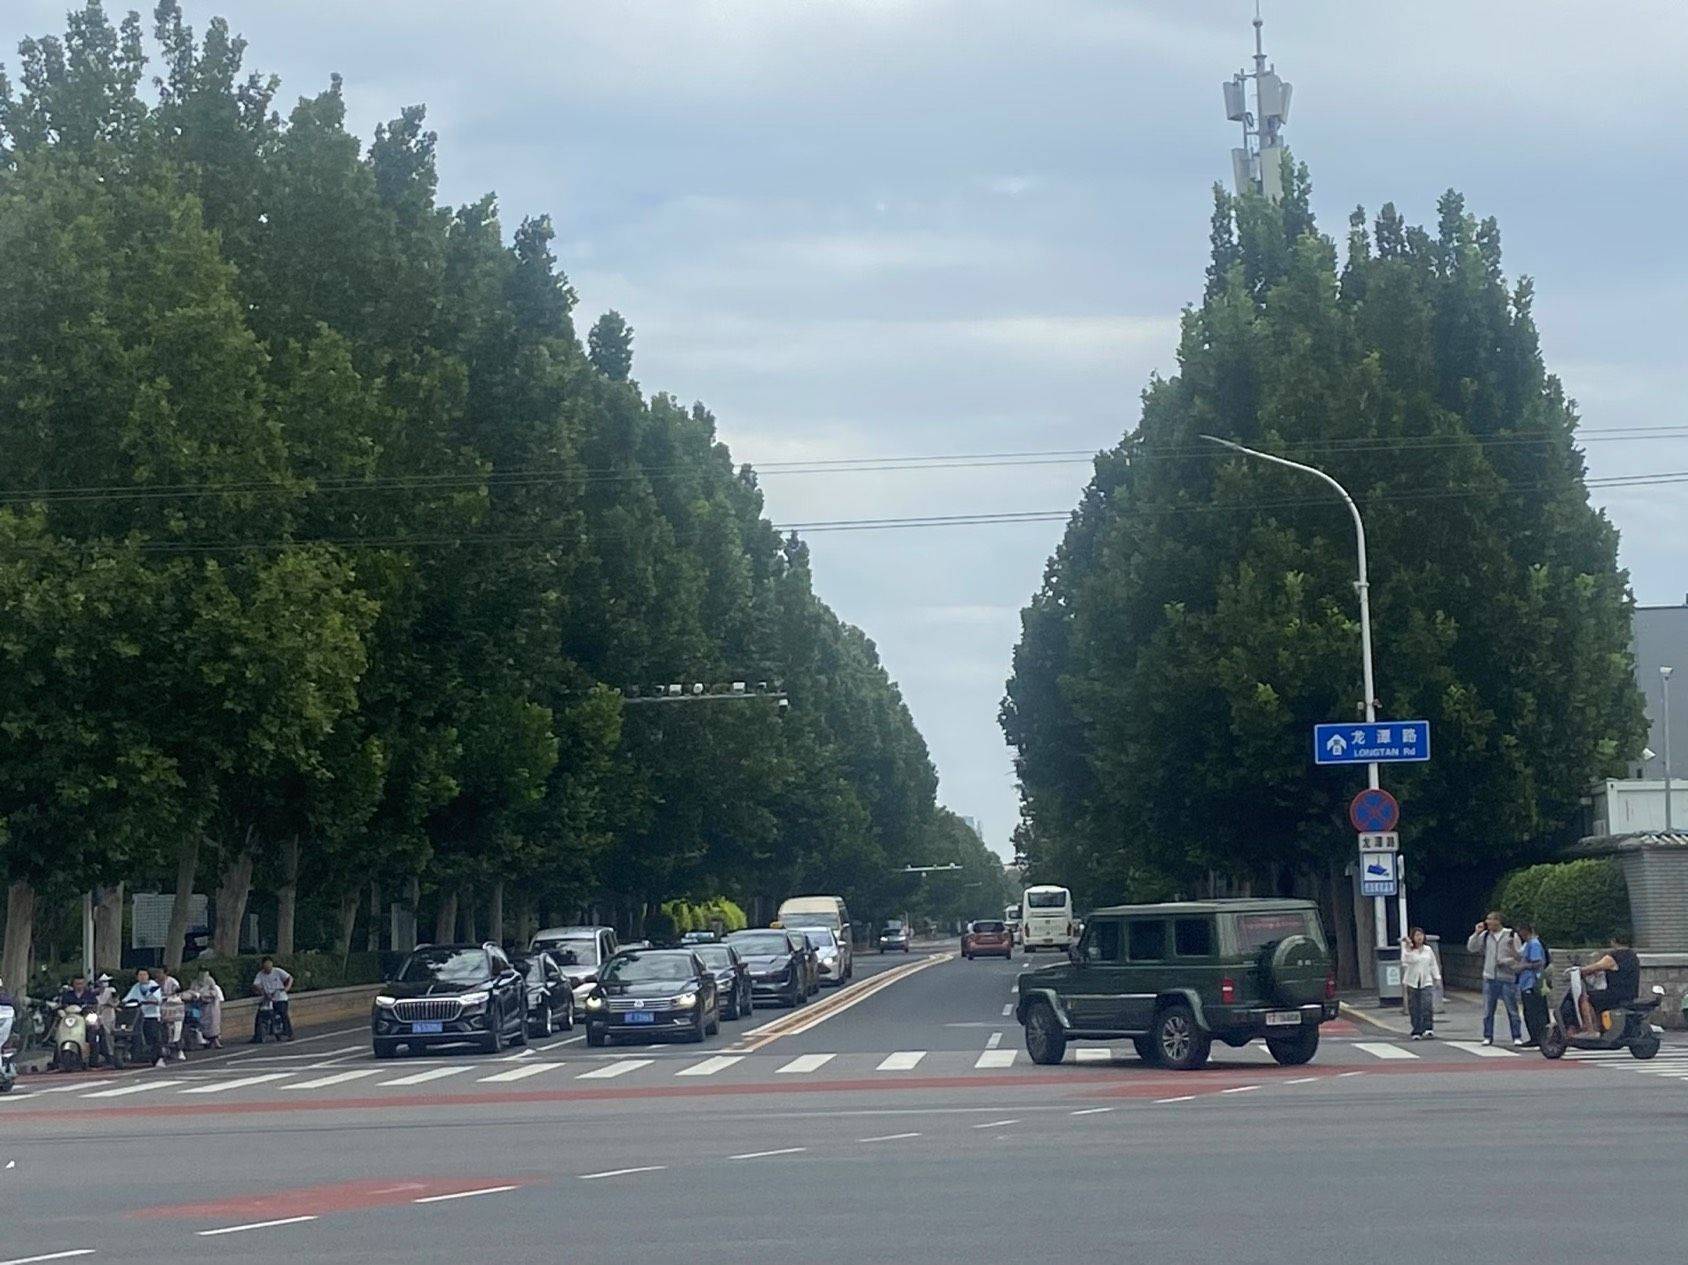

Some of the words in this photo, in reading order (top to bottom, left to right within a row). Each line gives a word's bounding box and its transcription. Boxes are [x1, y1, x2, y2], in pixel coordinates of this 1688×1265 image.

[1350, 728, 1417, 745] 龙潭路
[1354, 748, 1399, 757] LONGTAN
[1403, 747, 1416, 756] Rd
